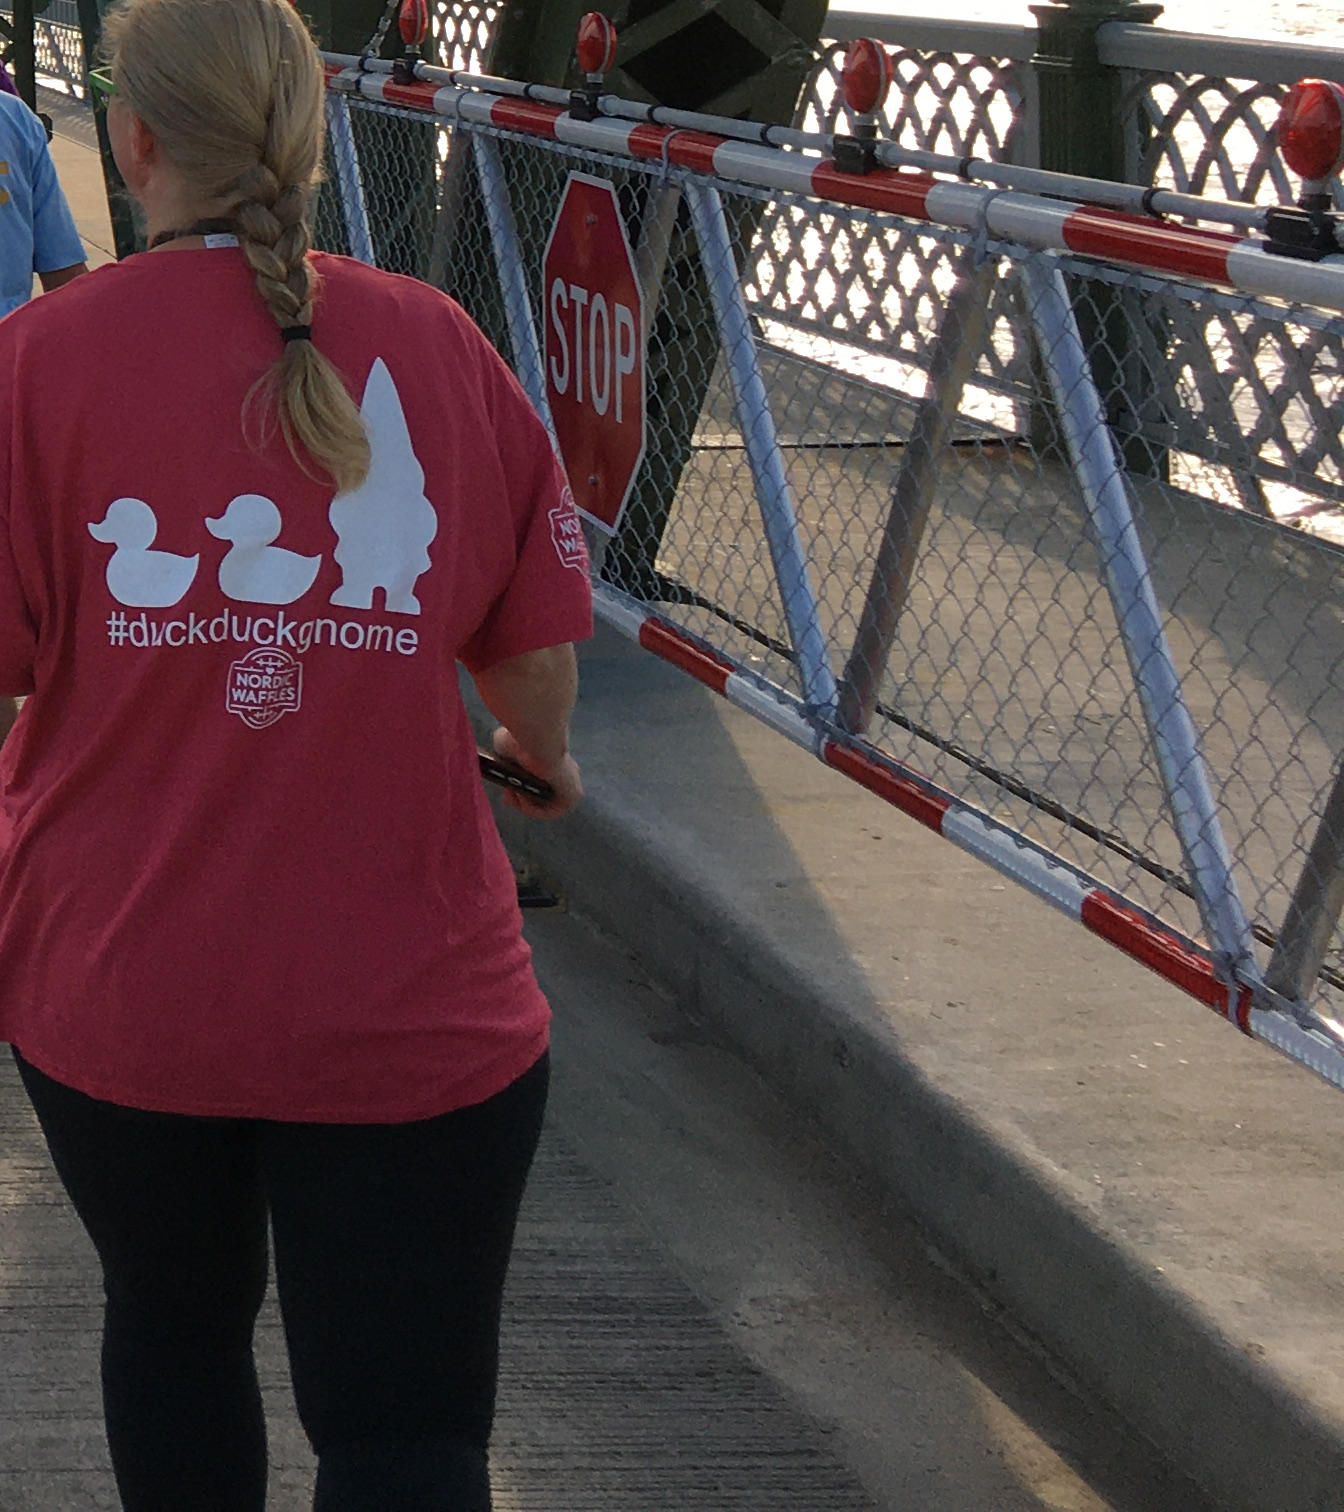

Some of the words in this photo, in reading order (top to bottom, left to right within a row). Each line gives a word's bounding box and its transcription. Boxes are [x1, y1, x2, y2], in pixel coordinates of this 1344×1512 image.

[550, 277, 636, 424] STOP
[106, 608, 419, 656] #duckduckgnome
[231, 687, 296, 704] WAFFLES
[236, 672, 294, 689] NORDIC
